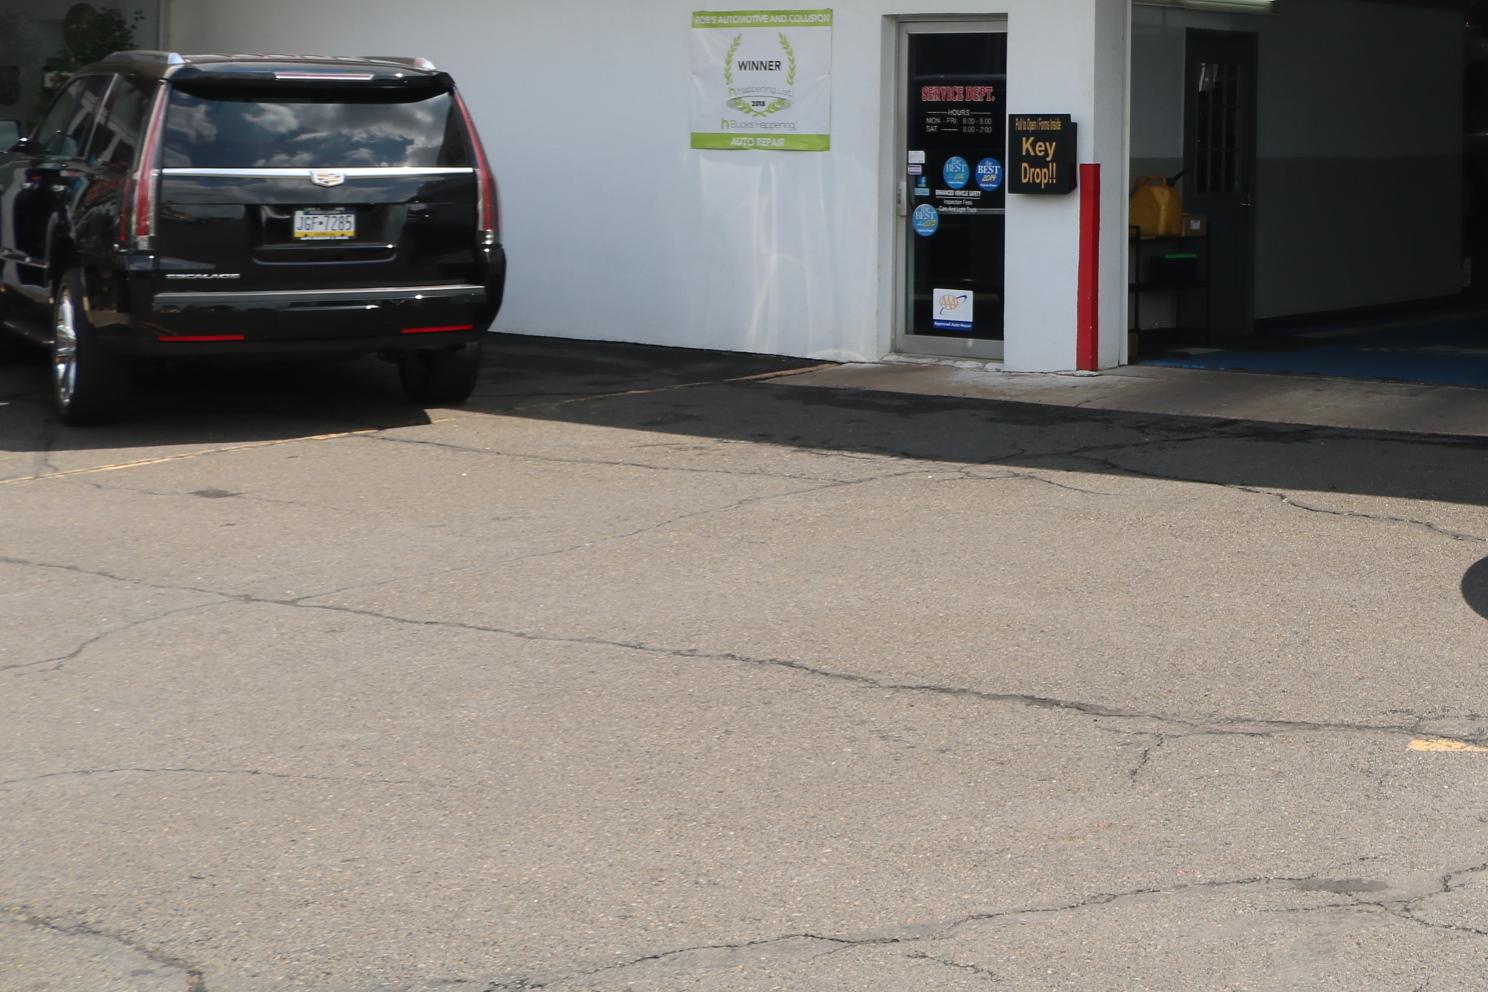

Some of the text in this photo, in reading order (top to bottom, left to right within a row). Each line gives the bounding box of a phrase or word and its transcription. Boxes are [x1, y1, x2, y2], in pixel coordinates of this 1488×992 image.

[695, 13, 830, 25] ROB'S AUTOMOTIVE AND COLLISION
[738, 60, 782, 71] WINNER
[921, 86, 996, 102] SERVICE DEPT.
[730, 120, 753, 129] Bucks
[731, 137, 785, 147] AUTO REPAIR
[1022, 137, 1056, 161] Key
[946, 164, 967, 173] BEST
[977, 165, 1000, 174] BEST
[1021, 162, 1056, 189] Drop!!
[915, 211, 936, 220] BEST
[940, 295, 958, 309] AAA
